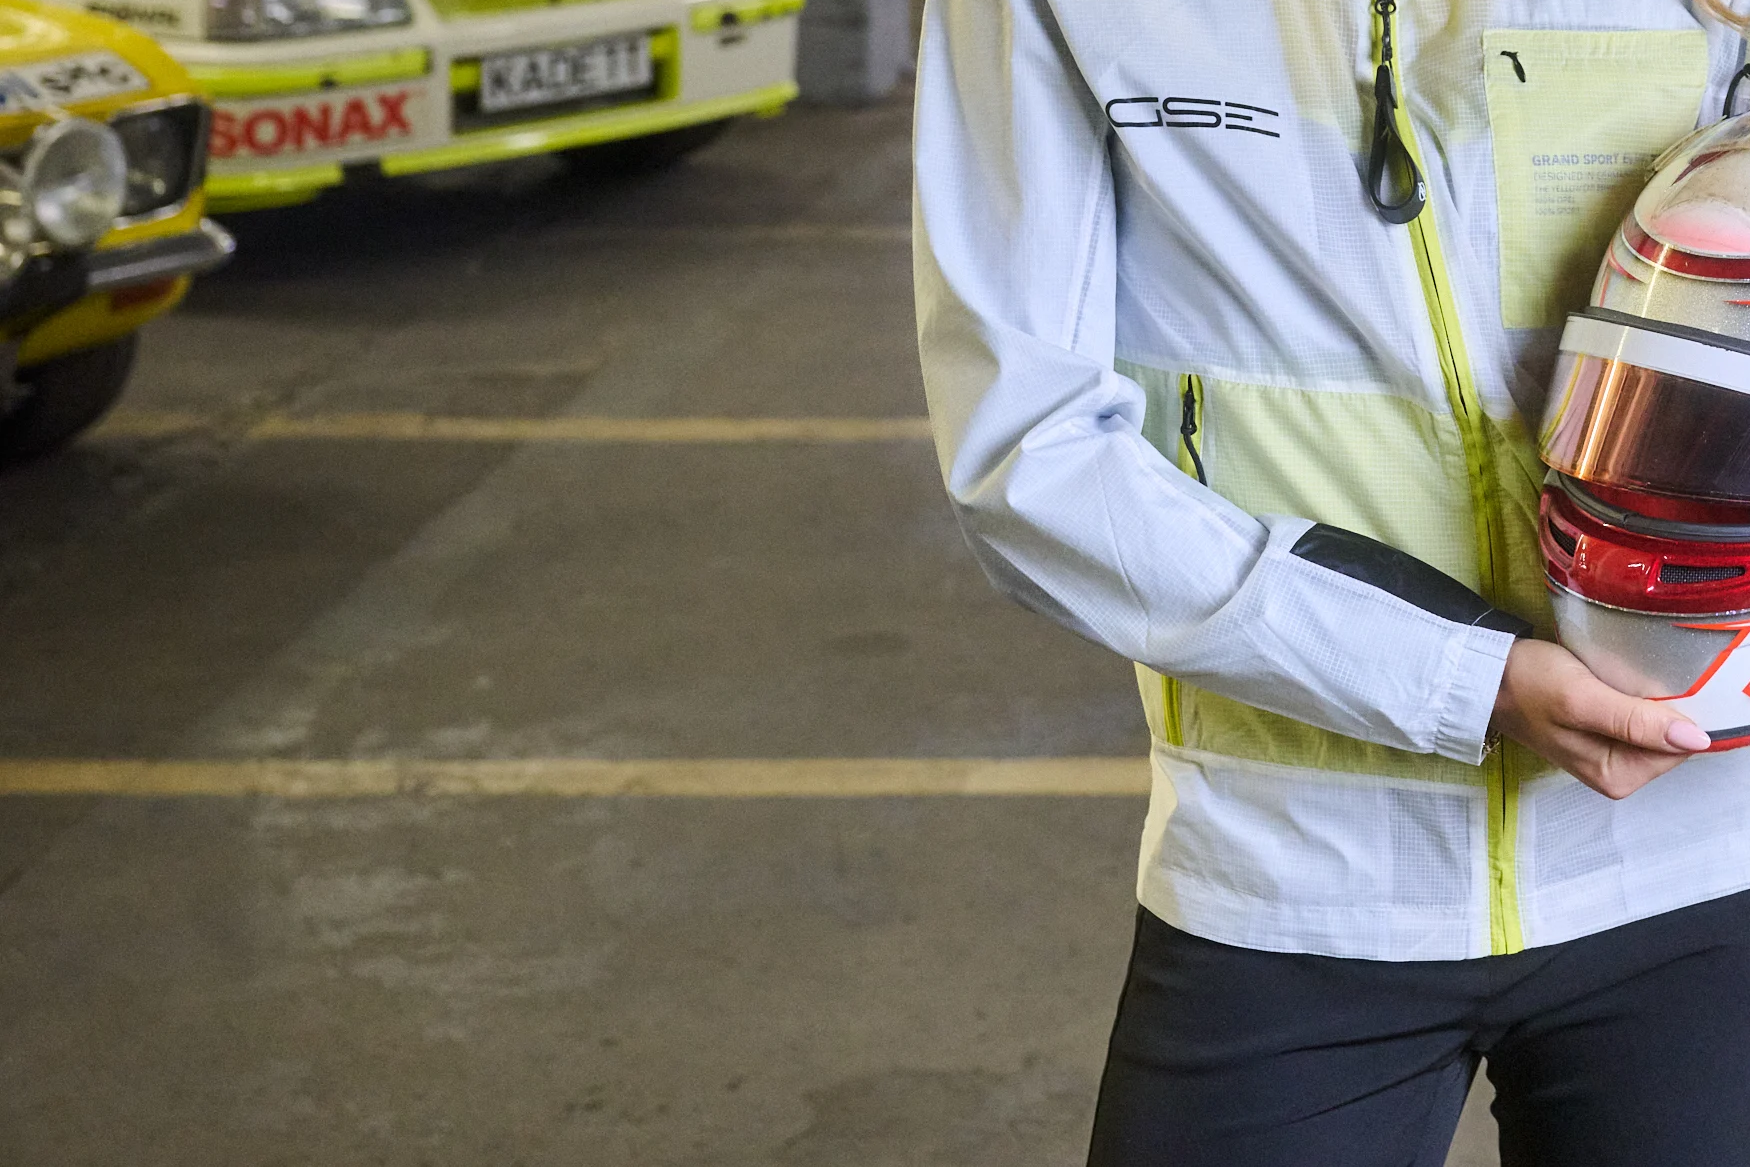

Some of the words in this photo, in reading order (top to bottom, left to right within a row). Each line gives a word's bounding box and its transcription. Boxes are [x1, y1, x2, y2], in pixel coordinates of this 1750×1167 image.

[207, 90, 412, 158] SONAX
[1532, 154, 1579, 166] GRAND
[1583, 153, 1619, 165] SPORT
[1533, 171, 1584, 181] DESIGNED
